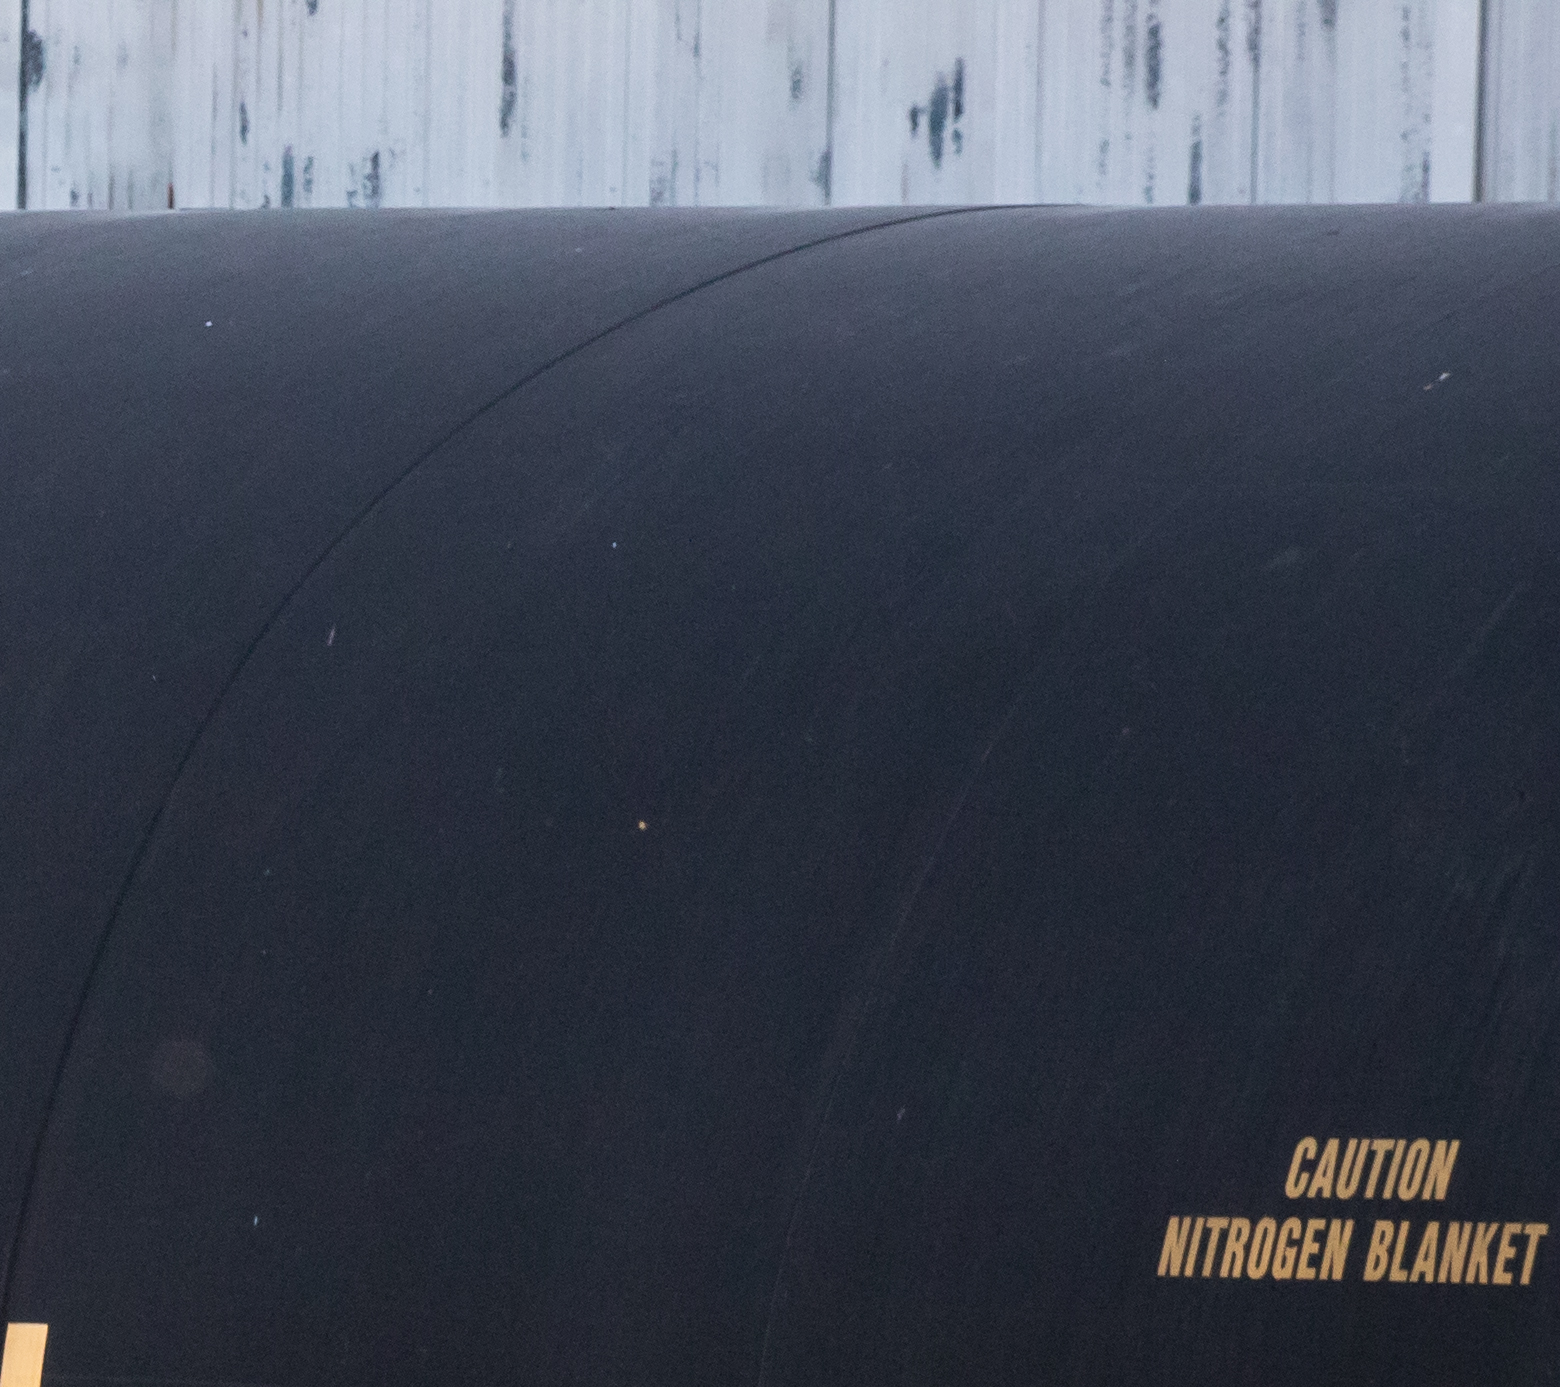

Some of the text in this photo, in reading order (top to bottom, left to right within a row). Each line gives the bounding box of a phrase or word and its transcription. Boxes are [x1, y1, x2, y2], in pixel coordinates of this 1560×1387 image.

[1284, 1136, 1461, 1201] CAUTION
[1157, 1215, 1550, 1286] NITROGEN BLANKET
